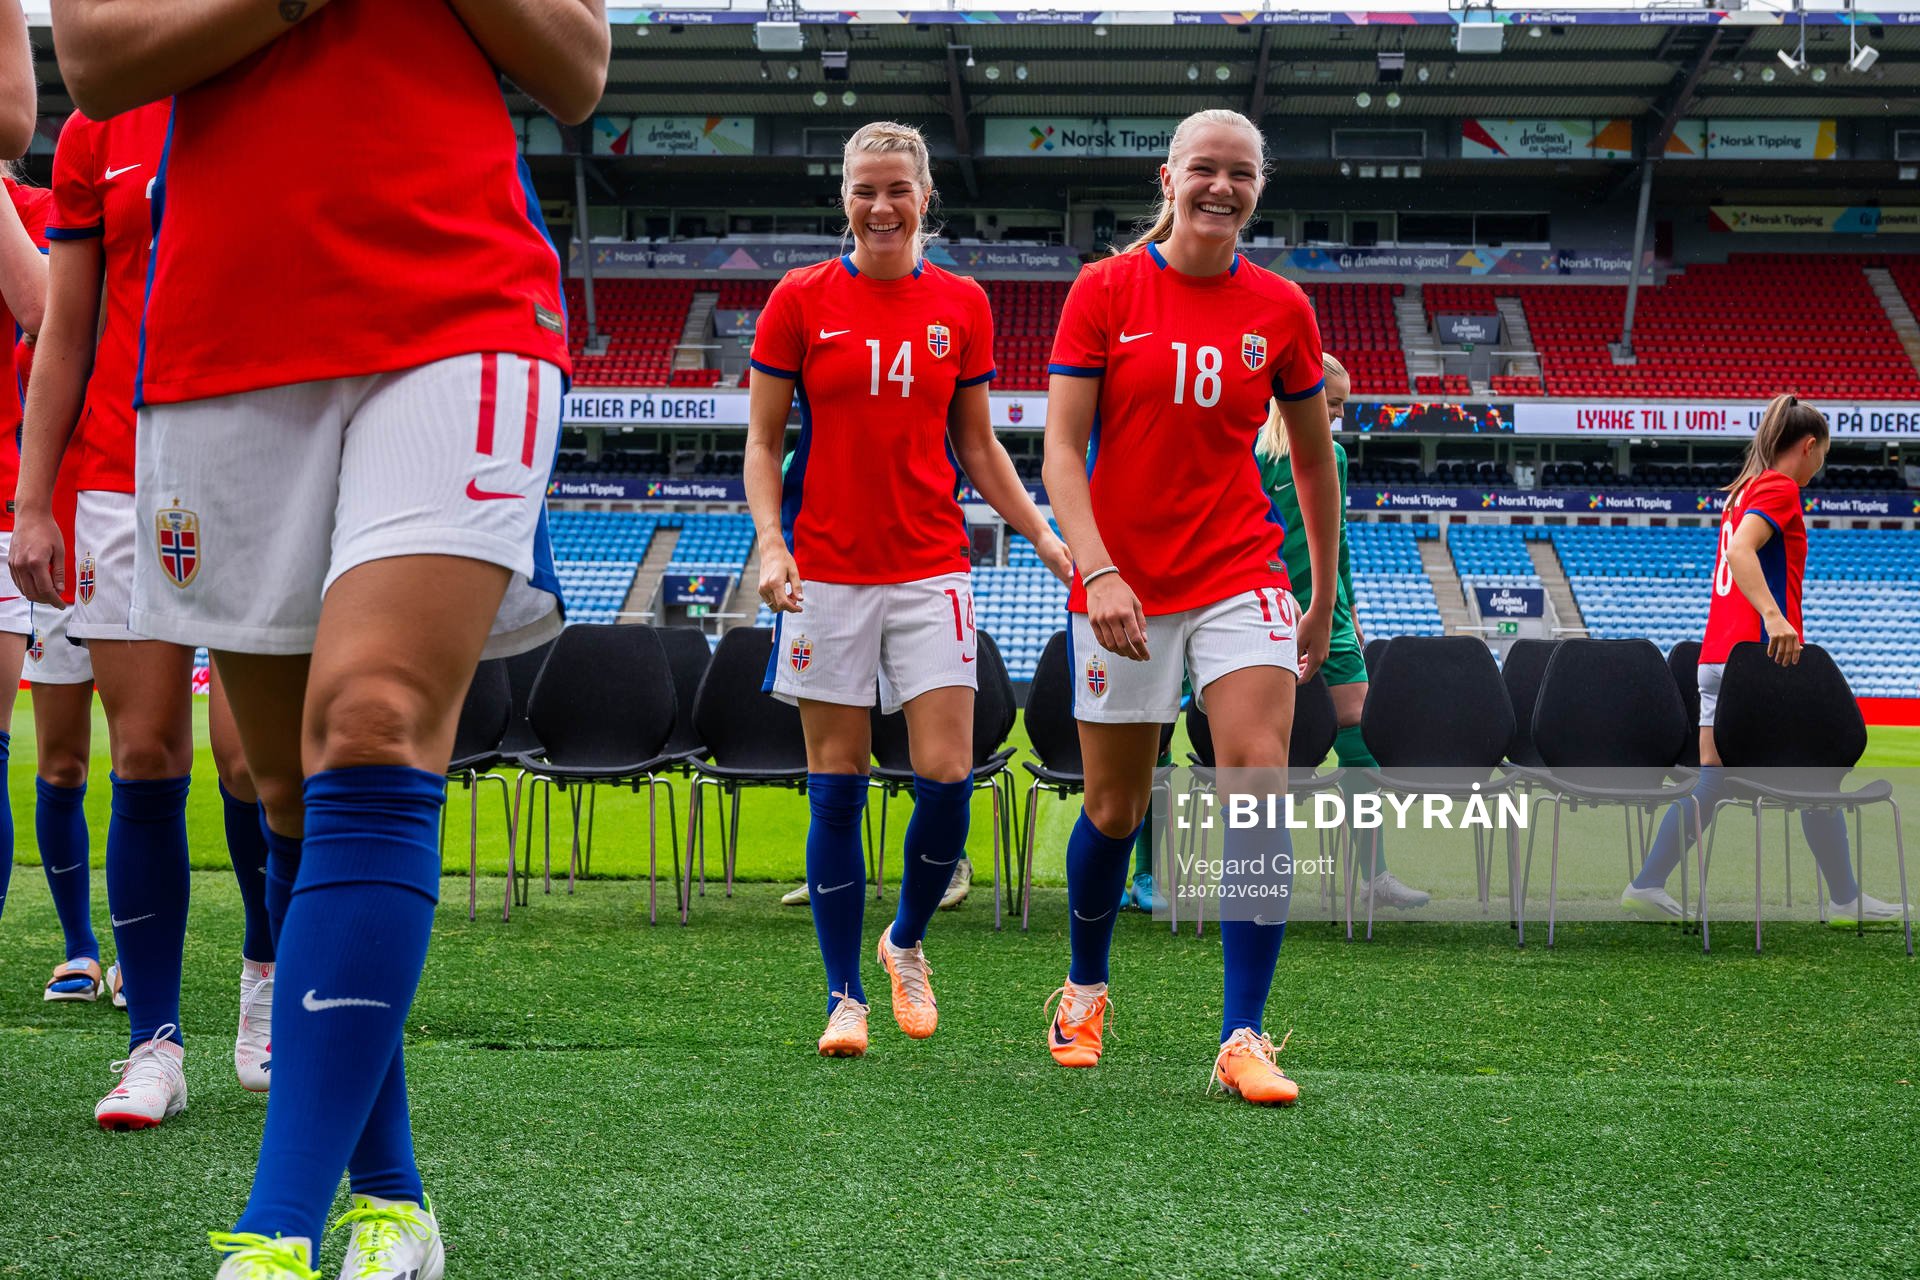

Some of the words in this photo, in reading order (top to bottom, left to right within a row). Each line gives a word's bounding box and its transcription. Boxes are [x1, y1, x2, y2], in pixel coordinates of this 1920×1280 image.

[1061, 130, 1116, 148] Norsk
[1119, 131, 1173, 152] Tippi
[1720, 135, 1755, 146] Norsk
[1757, 135, 1802, 149] Tipping
[1751, 213, 1779, 225] Norsk
[1780, 213, 1824, 227] Tipping
[615, 251, 646, 262] Norsk
[647, 251, 686, 264] Tipping
[987, 253, 1018, 264] Norsk
[1020, 253, 1059, 267] Tipping
[1560, 257, 1592, 269] Norsk
[1593, 257, 1632, 271] Tipping
[866, 339, 914, 397] 14
[1171, 342, 1222, 407] 18
[475, 352, 539, 469] 11
[571, 399, 623, 418] HEIER
[630, 394, 655, 418] PÅ
[661, 400, 715, 418] DERE!
[1577, 410, 1635, 429] LYKKE
[1640, 410, 1667, 429] TIL
[1674, 411, 1679, 429] I
[1837, 407, 1863, 432] PÅ
[562, 484, 590, 495] Norsk
[590, 484, 624, 497] Tipping
[663, 485, 691, 497] Norsk
[692, 485, 726, 499] Tipping
[1392, 494, 1420, 506] Norsk
[1420, 494, 1456, 508] Tipping
[1498, 496, 1526, 507] Norsk
[1526, 496, 1563, 509] Tipping
[1606, 497, 1634, 508] Norsk
[1634, 497, 1671, 511] Tipping
[1821, 500, 1850, 511] Norsk
[1851, 500, 1888, 514] Tipping
[944, 589, 975, 646] 14
